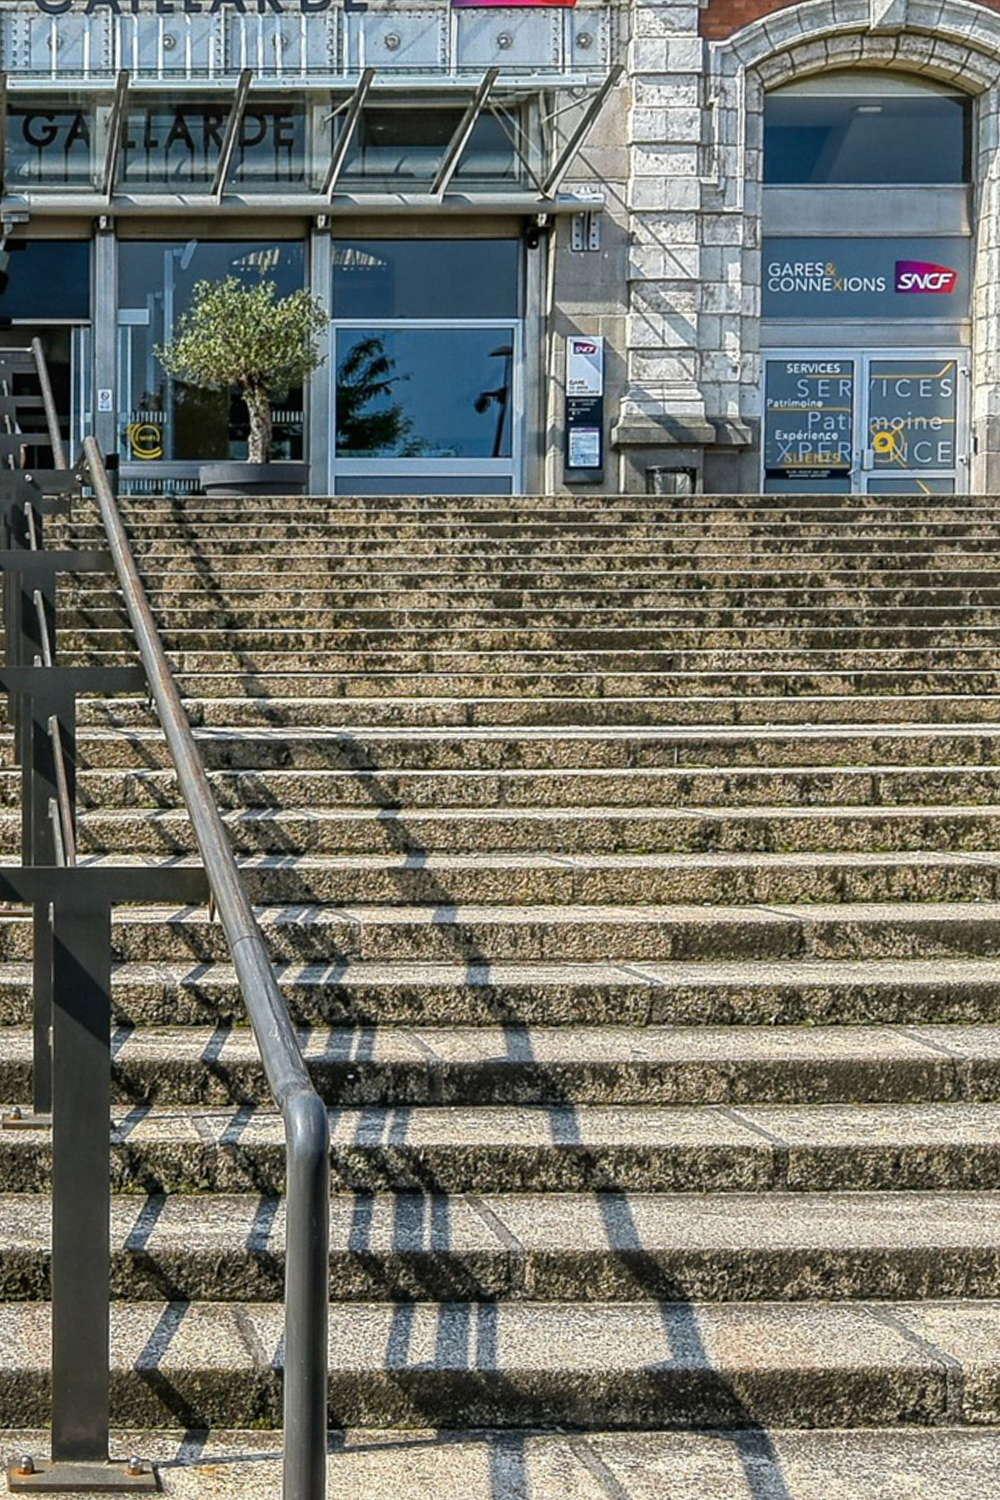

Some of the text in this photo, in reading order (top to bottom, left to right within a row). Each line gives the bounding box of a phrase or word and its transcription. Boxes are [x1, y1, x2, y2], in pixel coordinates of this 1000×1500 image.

[768, 277, 886, 292] CONNEXIONS
[897, 273, 953, 289] SNCF
[786, 363, 841, 374] SERVICES
[767, 399, 823, 408] Patrimoine
